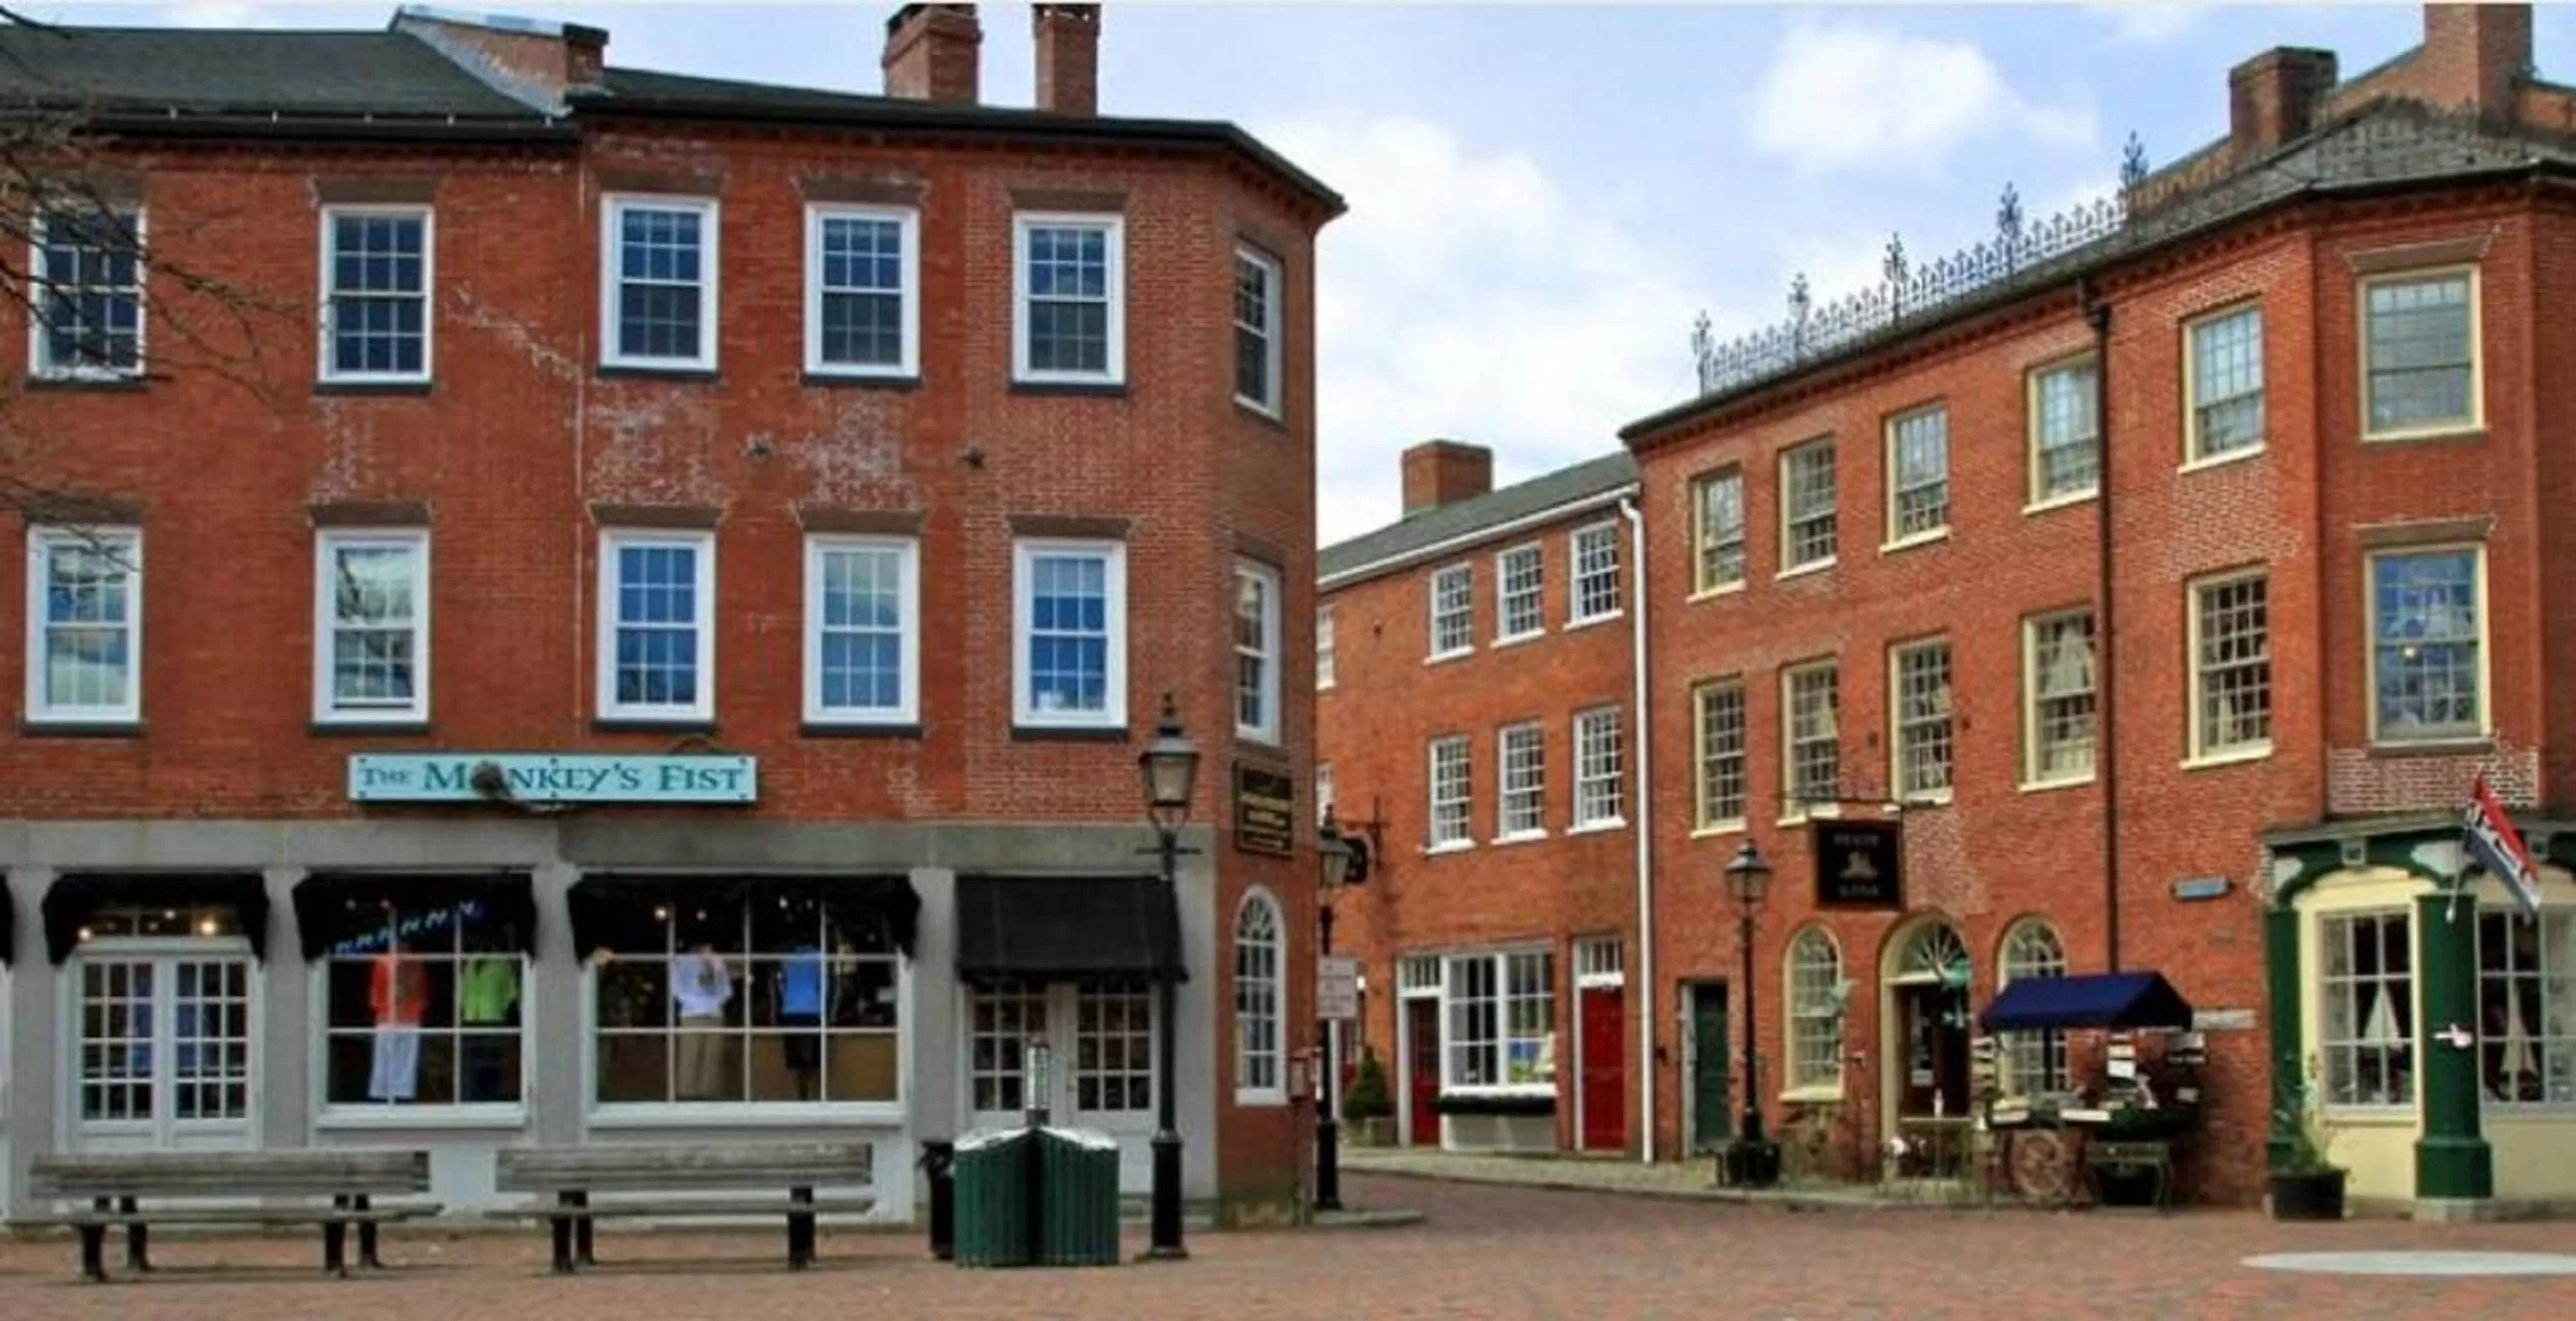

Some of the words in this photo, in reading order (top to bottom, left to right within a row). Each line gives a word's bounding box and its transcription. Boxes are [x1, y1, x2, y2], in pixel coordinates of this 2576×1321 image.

[360, 768, 409, 786] THE
[421, 761, 642, 792] MNKEY'S
[658, 764, 747, 791] FIST
